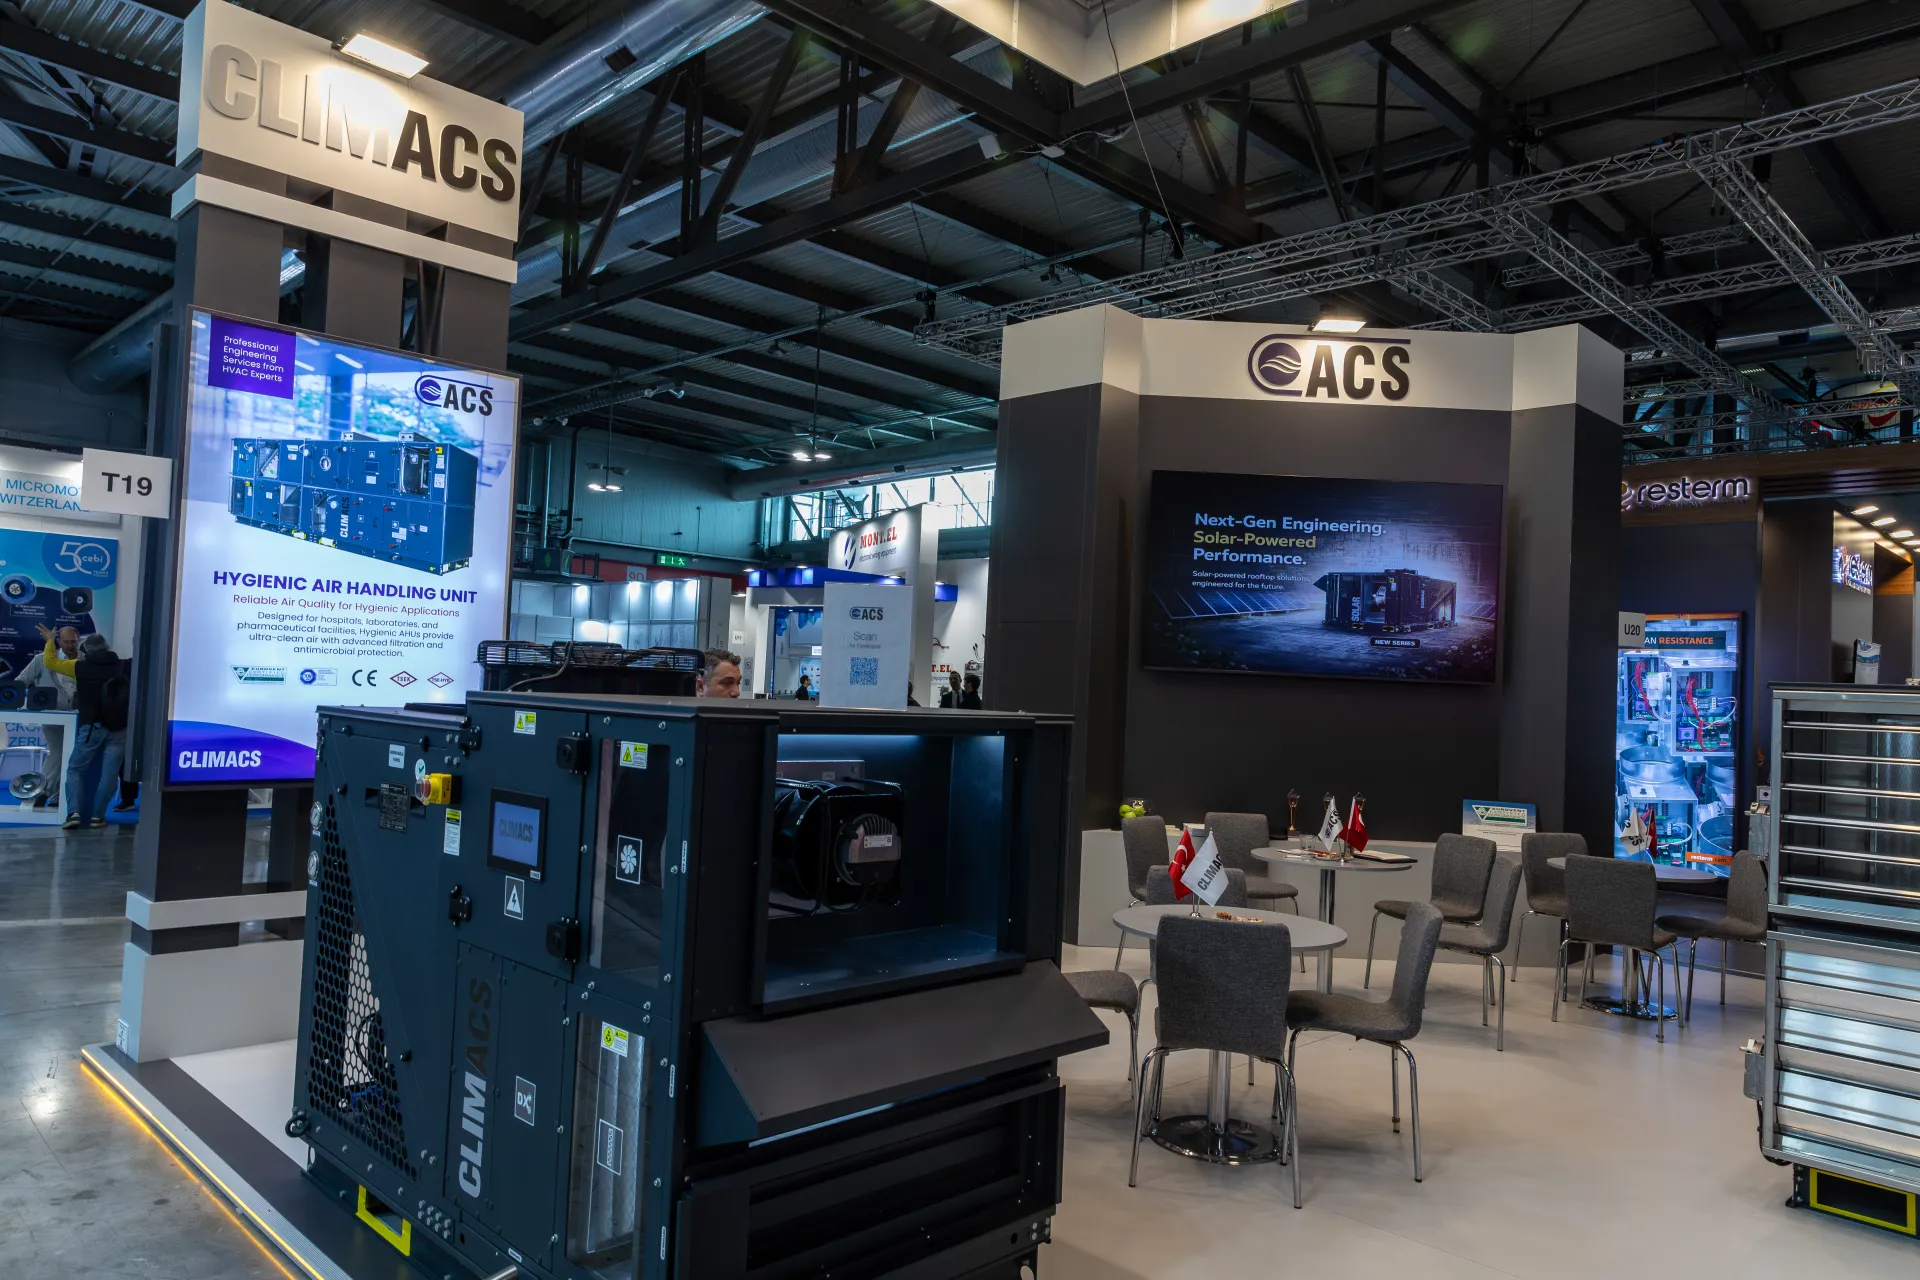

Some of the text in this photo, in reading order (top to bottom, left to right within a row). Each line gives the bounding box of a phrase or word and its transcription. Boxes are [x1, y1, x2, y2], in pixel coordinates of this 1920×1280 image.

[207, 43, 517, 202] CLIMACS
[224, 335, 279, 352] Professional
[223, 345, 277, 363] Engineering
[223, 355, 284, 373] Services from
[1305, 345, 1410, 401] ACS
[222, 365, 283, 383] HVAC Experts
[443, 383, 494, 416] ACS
[6, 478, 80, 497] MICROMO
[101, 471, 153, 497] T19
[1637, 477, 1749, 503] resterm
[0, 493, 86, 511] WITZERLAN
[1194, 512, 1387, 536] Next-Gen Engineering.
[860, 527, 897, 549] MONT.EL
[1193, 530, 1317, 549] Solar-Powered
[82, 553, 103, 563] cebi
[1193, 548, 1307, 565] Performance.
[1191, 580, 1234, 590] engineered
[1235, 581, 1246, 589] for
[1192, 570, 1312, 583] Solar-powered rooftop solutions,
[213, 570, 478, 603] HYGIENIC AIR HANDLING UNIT
[233, 594, 460, 617] Reliable Air Quality for Hygienic Applications
[862, 608, 883, 621] ACS
[1351, 596, 1360, 621] SOLAR
[257, 611, 439, 629] Designed for hospitals, laboratories, and
[237, 621, 454, 641] pharmaceutical facilities, Hygienic AHUs provide
[853, 631, 878, 642] Scan
[1624, 624, 1641, 636] U20
[249, 633, 444, 649] ultra-clean air with advanced filtration and
[1658, 637, 1714, 645] RESISTANCE
[293, 645, 404, 658] antimicrobial protection.
[178, 750, 262, 769] CLIMACS
[499, 818, 534, 843] CLIMACS
[458, 977, 492, 1199] CLIMACS
